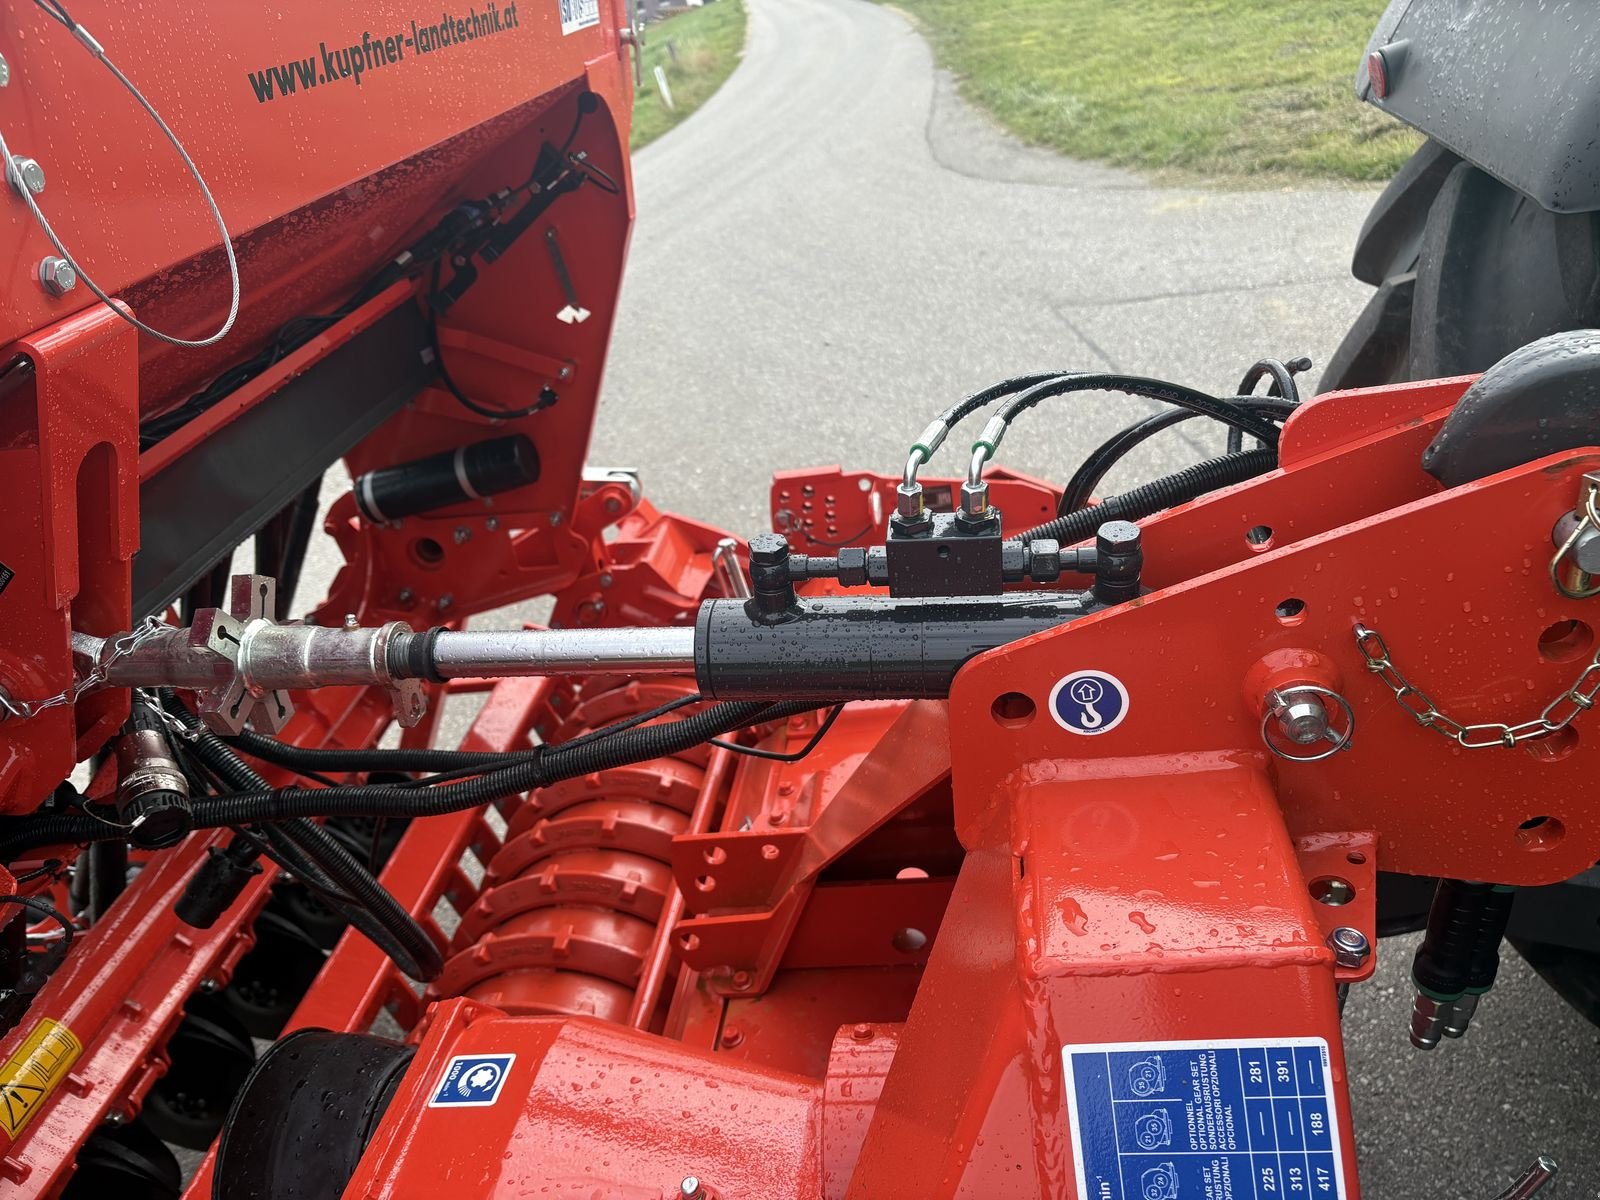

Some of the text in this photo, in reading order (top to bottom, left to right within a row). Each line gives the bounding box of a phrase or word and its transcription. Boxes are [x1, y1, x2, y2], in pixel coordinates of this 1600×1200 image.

[248, 1, 519, 104] www.kupfner-landtechnik.at
[449, 1062, 464, 1081] 1000
[1145, 1070, 1152, 1078] 21
[1248, 1061, 1263, 1083] 281
[1275, 1060, 1290, 1083] 391
[1190, 1060, 1208, 1150] OPTIONAL GEAR SET
[1199, 1053, 1217, 1150] SONDERAUSRUSTUNG
[1208, 1050, 1227, 1150] ACCESSORI OPZIONALI
[1186, 1100, 1198, 1150] OPTIONNEL
[1224, 1104, 1237, 1150] OPCIONAL
[1310, 1112, 1324, 1136] 188
[1145, 1135, 1152, 1143] 21
[1202, 1166, 1212, 1184] SET
[1261, 1167, 1276, 1192] 225
[1289, 1167, 1303, 1191] 313
[1316, 1167, 1331, 1192] 417
